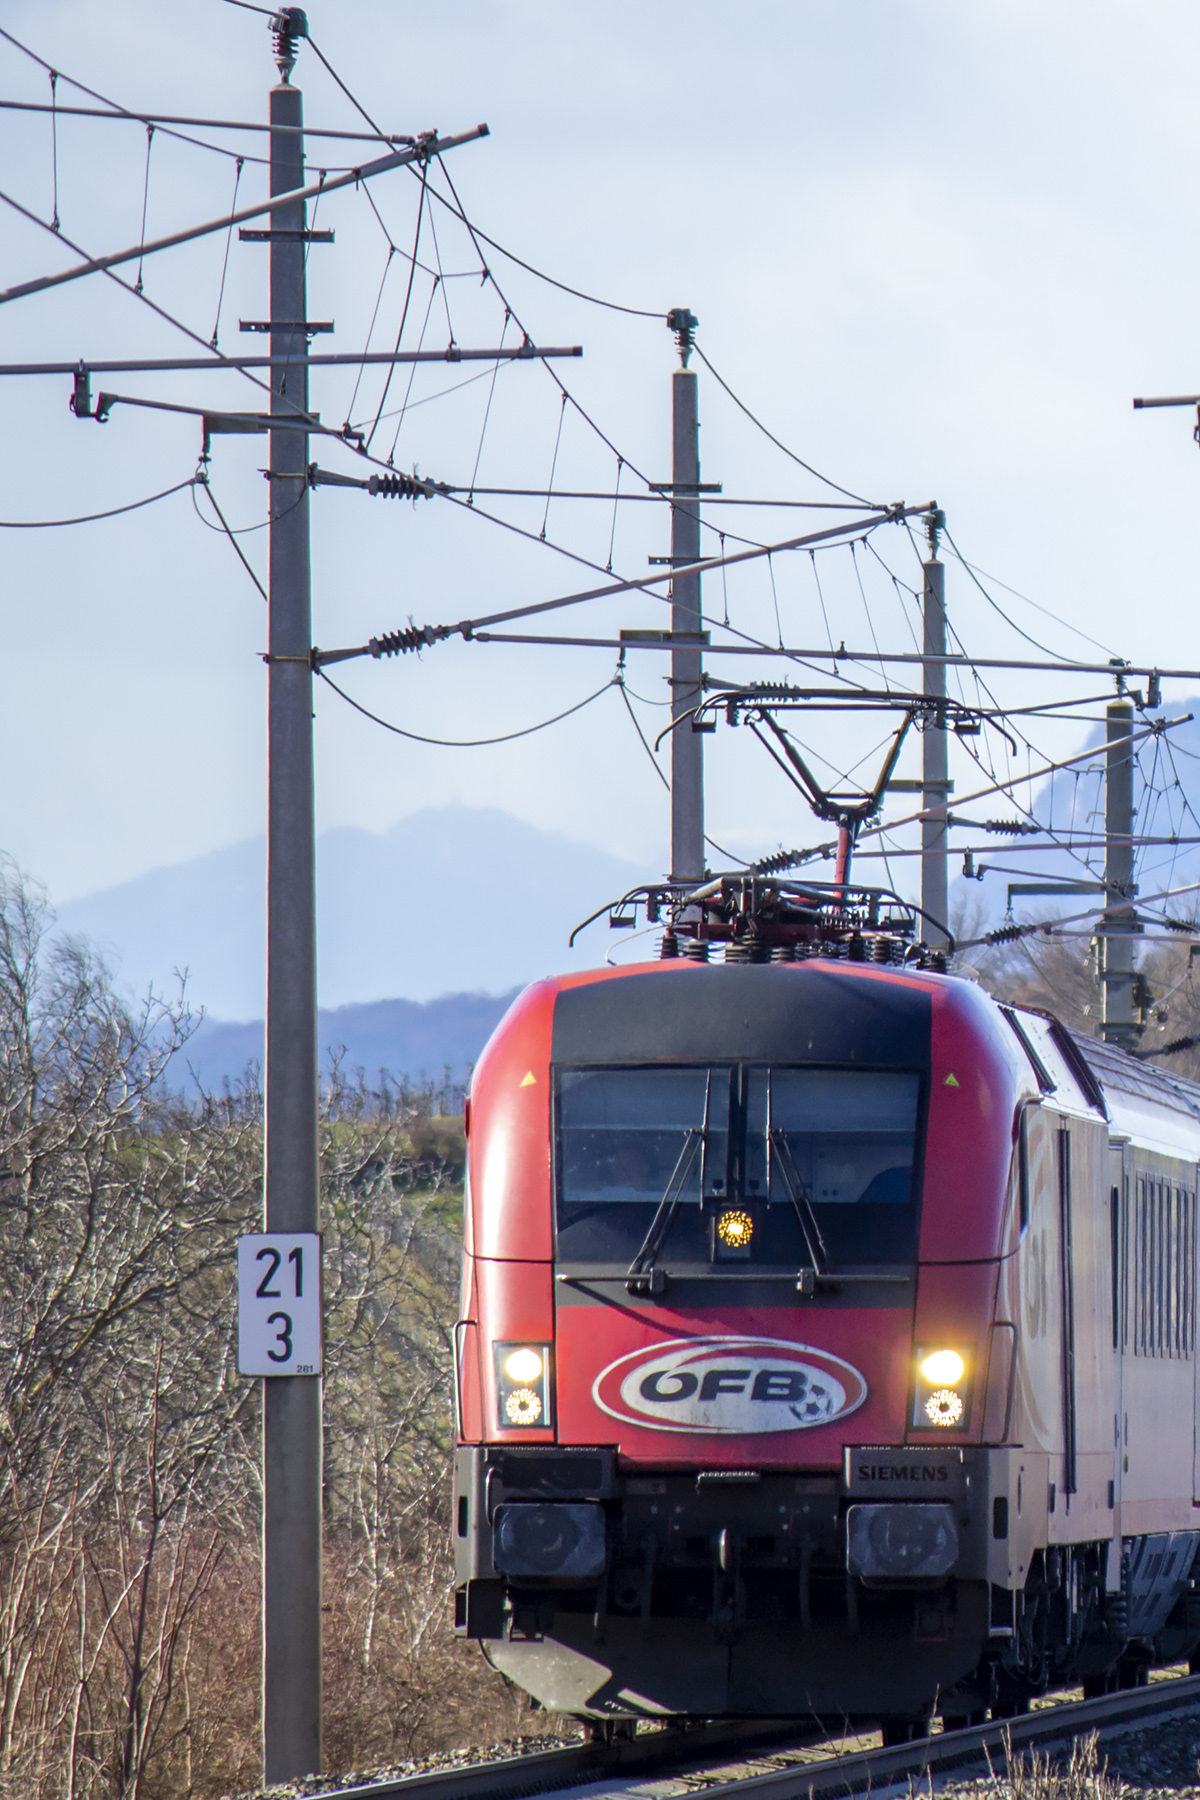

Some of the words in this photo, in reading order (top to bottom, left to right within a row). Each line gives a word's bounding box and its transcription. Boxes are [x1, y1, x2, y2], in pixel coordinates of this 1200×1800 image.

[256, 1247, 303, 1298] 21
[267, 1311, 293, 1363] 3
[297, 1365, 314, 1373] 281
[858, 1465, 949, 1481] SIEMENS
